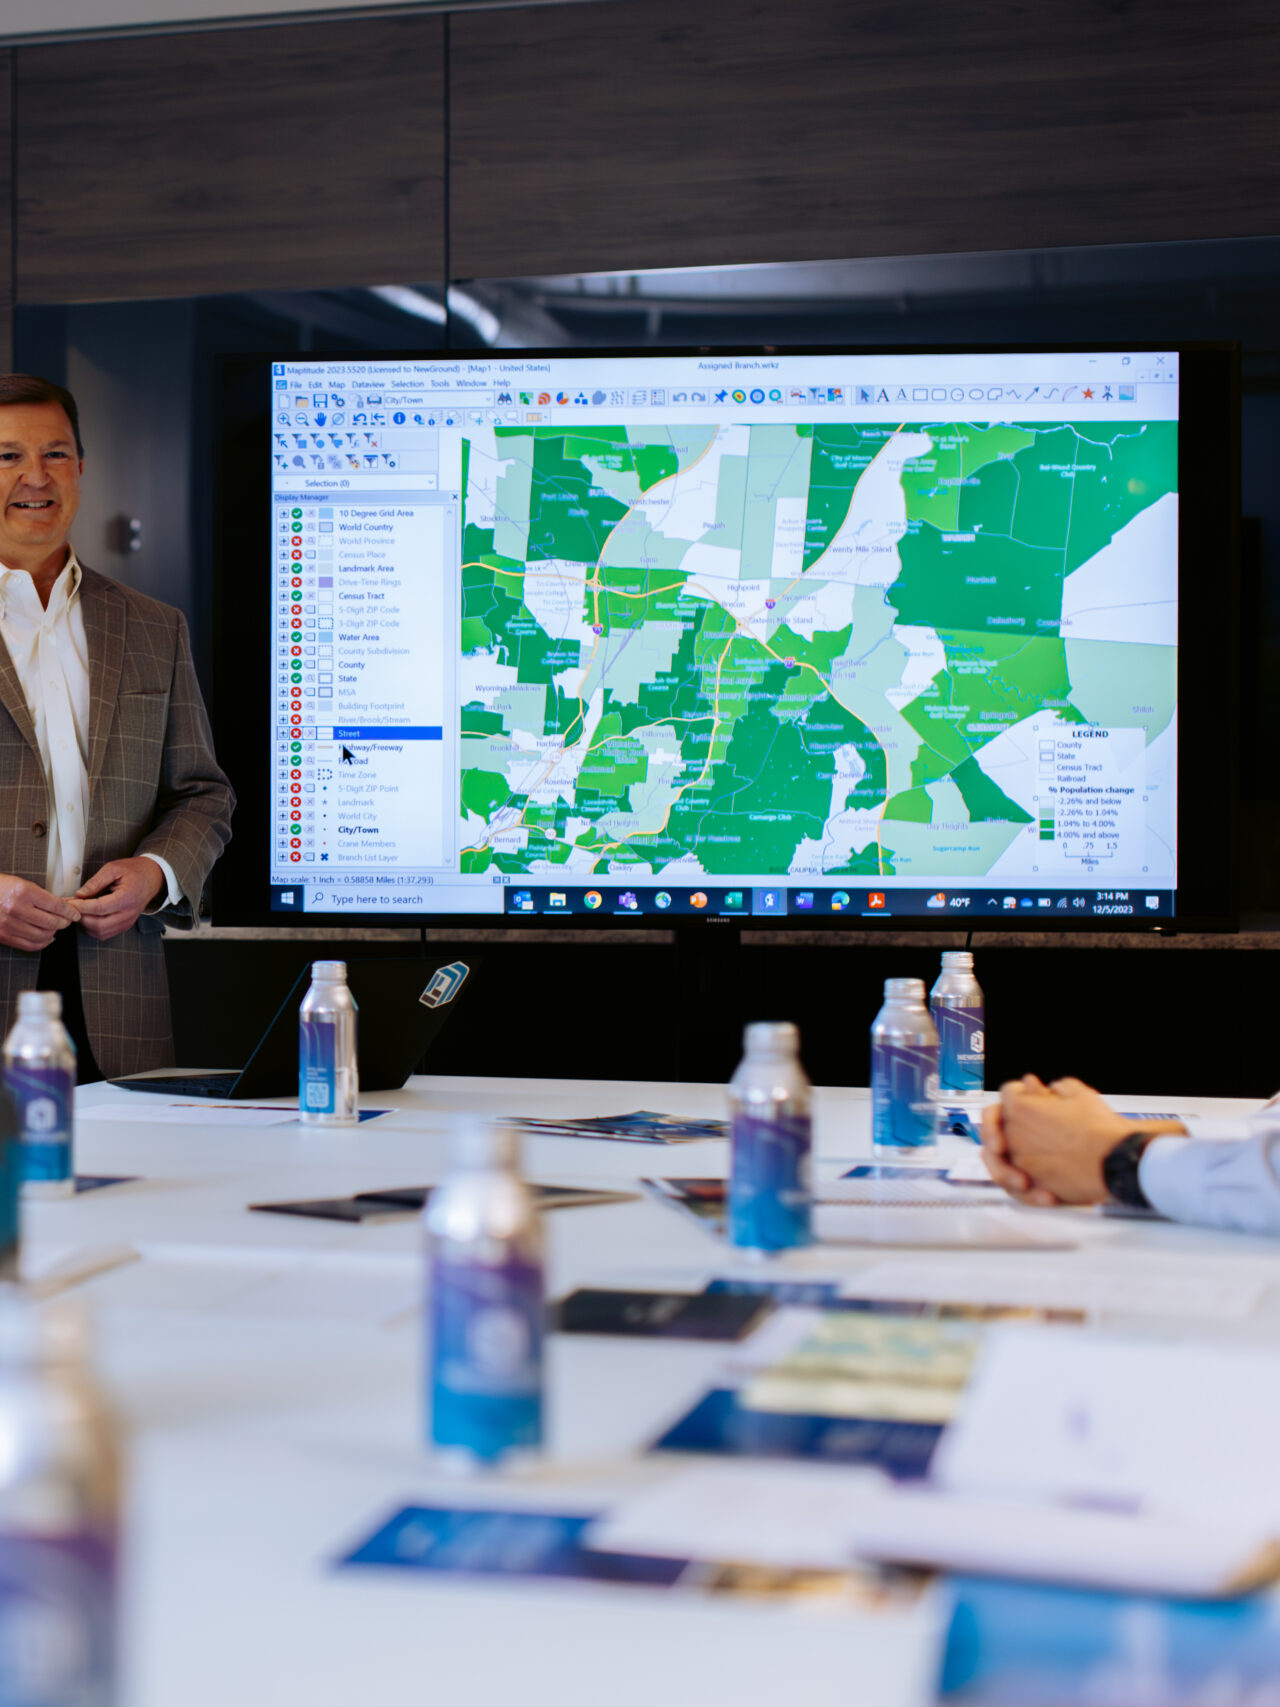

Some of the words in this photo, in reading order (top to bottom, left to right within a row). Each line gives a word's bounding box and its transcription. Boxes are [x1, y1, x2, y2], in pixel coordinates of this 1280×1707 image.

[287, 366, 325, 375] Maptitude
[368, 365, 401, 374] (Licensed
[403, 365, 411, 373] to
[413, 364, 460, 373] NewGround)
[499, 364, 524, 372] United
[526, 364, 551, 373] States]
[698, 362, 732, 371] Assigned
[290, 381, 302, 389] File
[308, 381, 322, 389] Edit
[329, 381, 345, 390] Map
[352, 380, 385, 388] Dataview
[391, 380, 424, 388] Selection
[493, 379, 511, 388] Help
[385, 396, 424, 405] City/Town
[305, 480, 338, 488] Selection
[339, 480, 350, 489] (0)
[275, 494, 299, 502] Display
[339, 509, 348, 517] 10
[351, 509, 377, 519] Degree
[379, 509, 395, 517] Grid
[397, 509, 414, 517] Area
[339, 523, 361, 531] World
[364, 523, 393, 533] Country
[339, 537, 361, 545] World
[364, 537, 395, 545] Province
[339, 551, 365, 559] Census
[367, 551, 386, 559] Place
[339, 565, 375, 573] Landmark
[377, 565, 394, 573] Area
[377, 579, 401, 587] Rings
[727, 584, 760, 592] Highpoint
[338, 592, 365, 600] Census
[366, 592, 385, 600] Tract
[339, 606, 364, 615] 5-Digit
[366, 606, 378, 614] ZIP
[380, 606, 400, 614] Code
[366, 620, 378, 628] ZIP
[380, 620, 400, 628] Code
[338, 633, 360, 641] Water
[362, 633, 380, 641] Area
[338, 647, 365, 656] County
[367, 647, 410, 655] Subdivision
[338, 661, 365, 670] County
[338, 702, 368, 711] Building
[370, 702, 405, 711] Footprint
[338, 730, 360, 738] Street
[1072, 730, 1109, 738] LEGEND
[338, 744, 404, 752] Hhway/Freeway
[1057, 742, 1082, 750] County
[338, 771, 356, 779] Time
[358, 771, 376, 779] Zone
[338, 785, 363, 794] 5-Digit
[365, 785, 378, 793] ZIP
[379, 785, 399, 793] Point
[1049, 786, 1058, 794] %
[1060, 786, 1107, 795] Population
[1109, 786, 1135, 795] change
[338, 798, 374, 807] Landmark
[1100, 797, 1122, 805] below
[338, 812, 361, 820] World
[363, 812, 377, 821] City
[338, 826, 379, 835] City/Town
[1082, 831, 1096, 839] and
[1098, 831, 1120, 839] above
[338, 840, 359, 848] Crane
[361, 840, 396, 848] Members
[338, 854, 361, 862] Branch
[366, 854, 377, 862] List
[379, 854, 398, 863] Layer
[271, 876, 289, 885] Map
[290, 876, 309, 884] scale:
[320, 876, 334, 884] Inch
[376, 876, 395, 884] Miles
[332, 895, 354, 906] Type
[356, 895, 373, 904] here
[375, 895, 384, 904] to
[385, 895, 423, 904] search
[1096, 892, 1113, 901] 3:14
[1115, 892, 1129, 901] PM
[949, 897, 971, 908] 40°F
[1092, 905, 1133, 915] 12/5/2023
